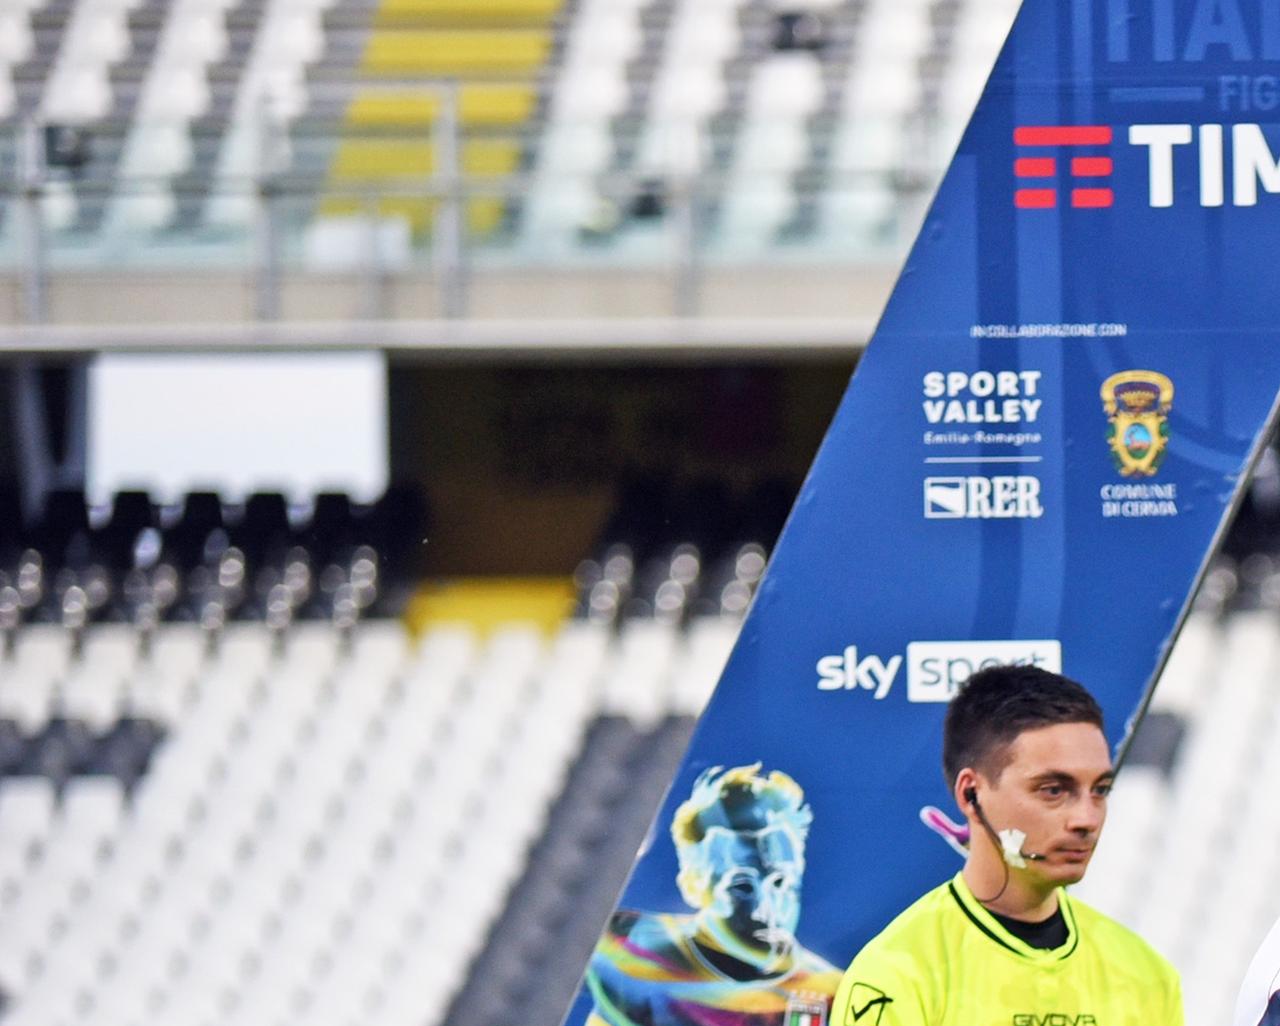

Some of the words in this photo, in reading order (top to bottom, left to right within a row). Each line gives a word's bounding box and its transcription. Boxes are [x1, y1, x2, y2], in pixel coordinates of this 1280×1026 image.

[923, 371, 1041, 397] SPORT
[922, 399, 1042, 423] VALLEY
[924, 431, 1041, 446] Emilia-Romagna
[967, 476, 1044, 518] RER
[1100, 483, 1176, 500] COMUNE
[816, 645, 903, 700] sky
